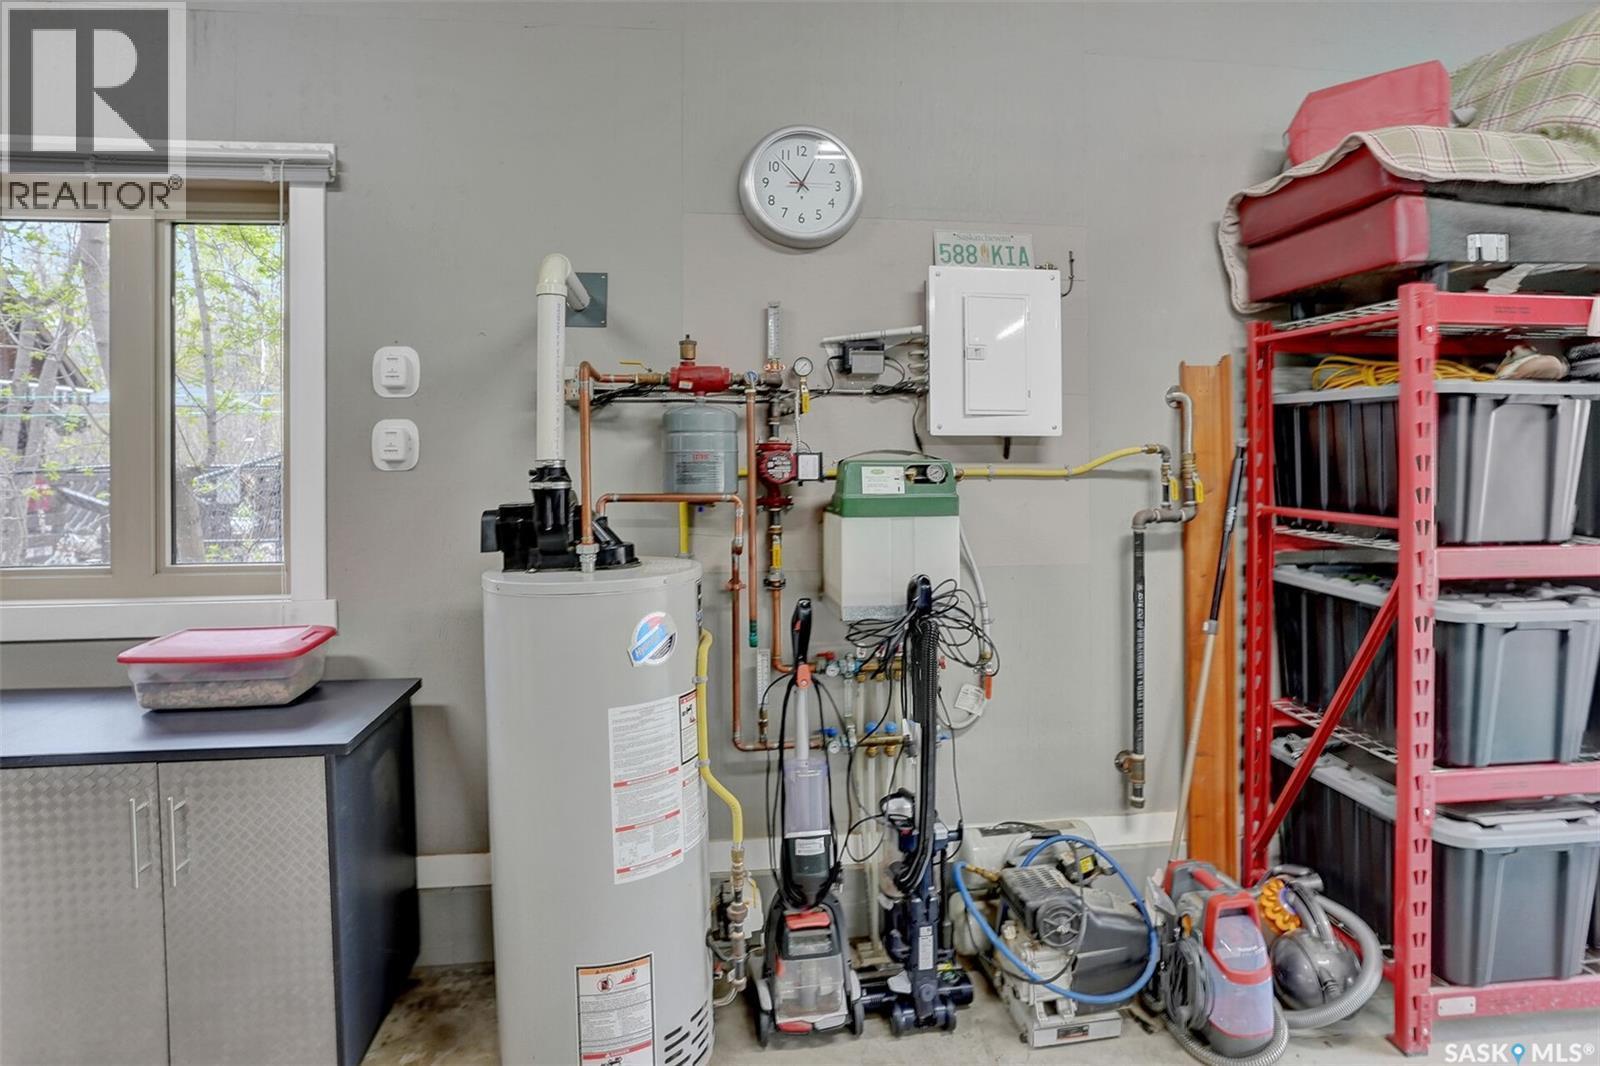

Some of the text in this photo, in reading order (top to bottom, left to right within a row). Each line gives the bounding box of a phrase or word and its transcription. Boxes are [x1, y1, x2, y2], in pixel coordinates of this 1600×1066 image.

[781, 149, 791, 161] 11
[796, 145, 808, 157] 12
[768, 160, 780, 173] 10
[828, 162, 836, 174] 2
[761, 177, 770, 188] 9
[834, 180, 842, 192] 3
[767, 194, 776, 206] 8
[827, 198, 836, 208] 4
[781, 207, 789, 218] 7
[797, 212, 806, 224] 6
[815, 209, 823, 221] 5
[938, 243, 1030, 267] 588 KIA
